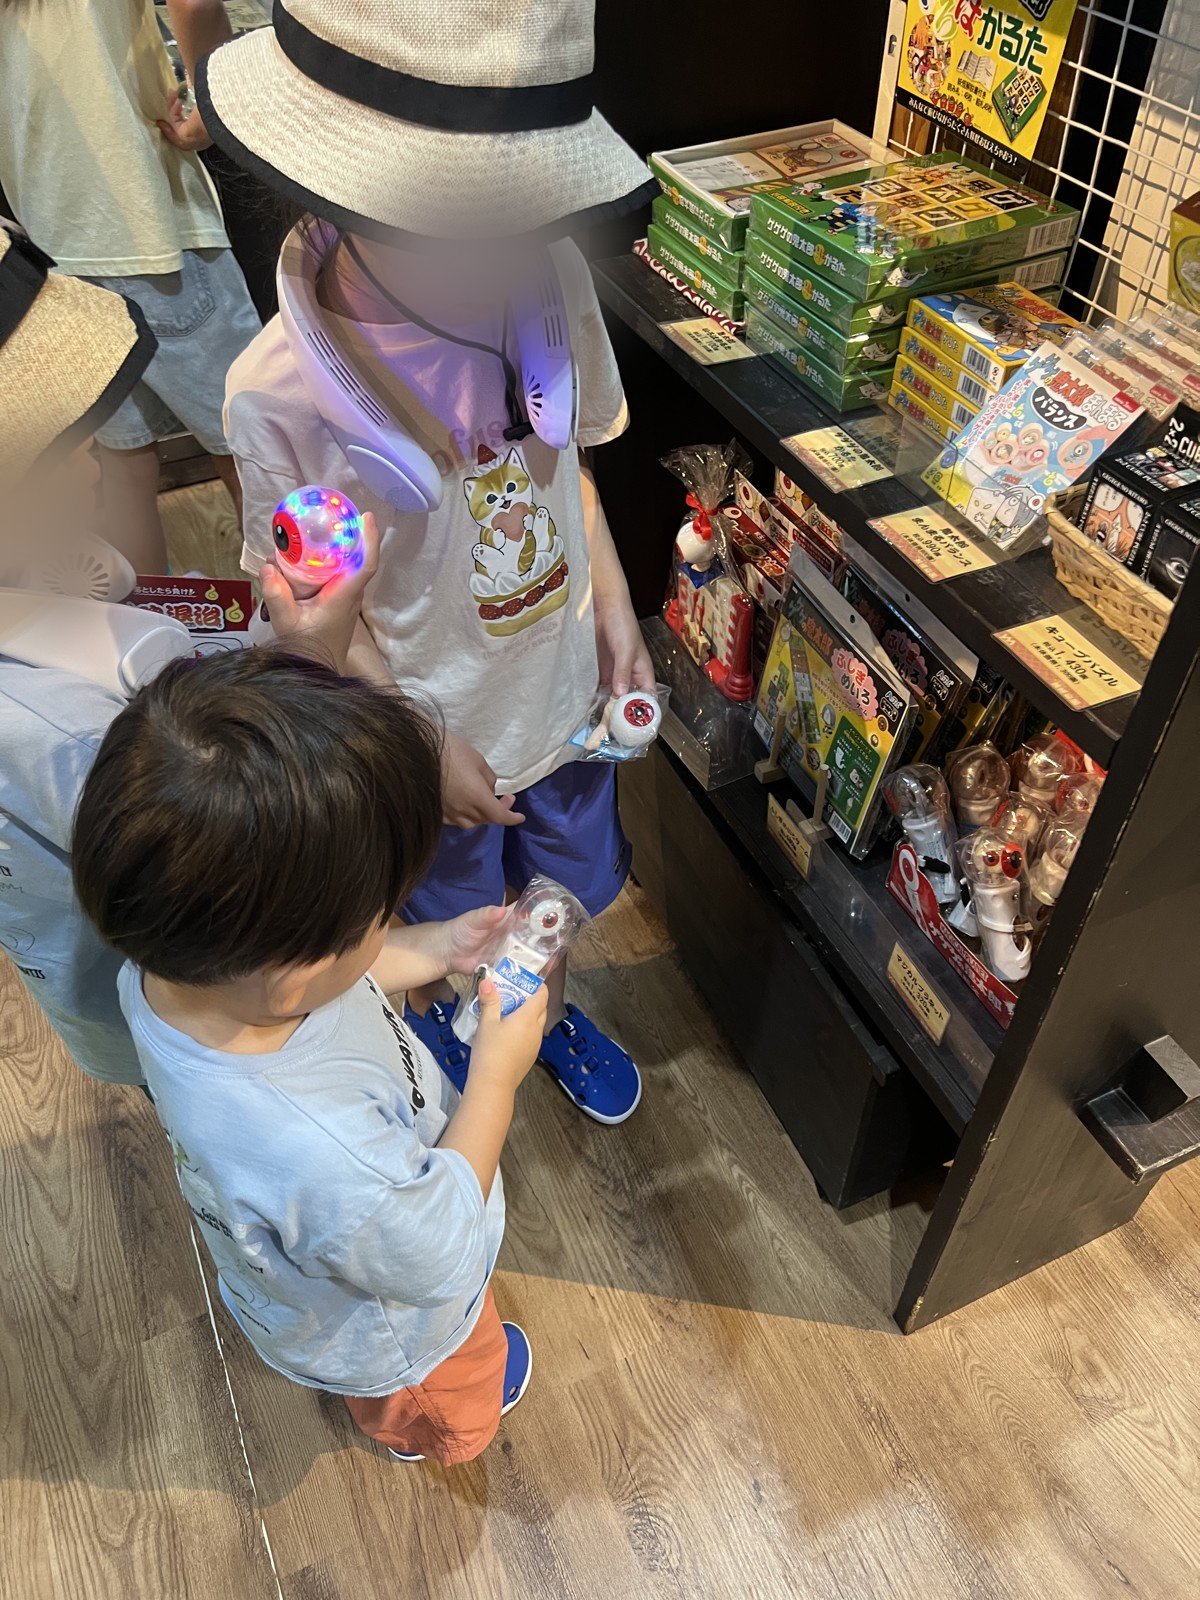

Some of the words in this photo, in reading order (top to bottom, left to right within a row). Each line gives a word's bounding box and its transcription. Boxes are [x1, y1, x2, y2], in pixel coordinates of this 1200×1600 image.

[1034, 395, 1080, 430] バランス
[911, 517, 972, 567] まんまるバランス
[835, 652, 868, 686] ふしぎ
[1044, 626, 1119, 687] キューブパズル
[839, 674, 871, 705] めいろ
[895, 954, 945, 1021] マジカルプラネット
